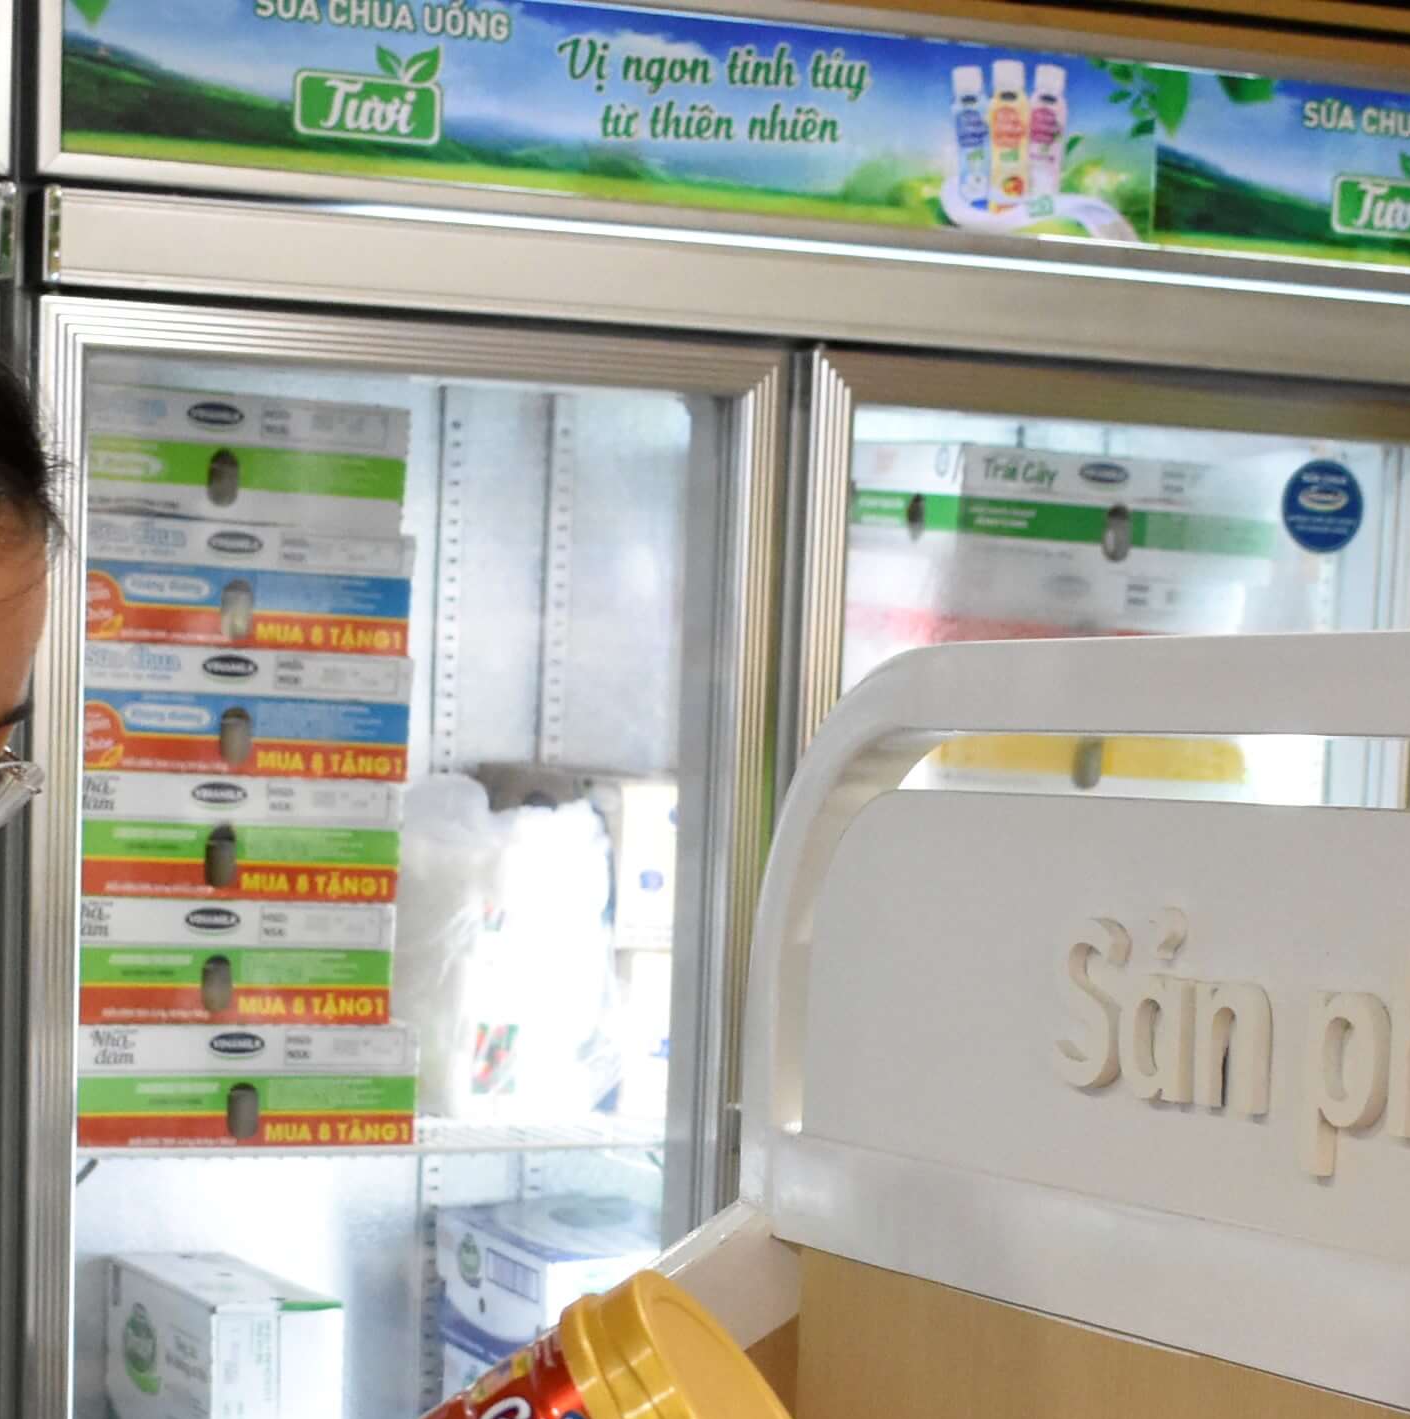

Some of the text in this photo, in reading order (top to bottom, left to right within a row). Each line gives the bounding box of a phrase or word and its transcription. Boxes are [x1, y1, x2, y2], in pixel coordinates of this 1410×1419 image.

[329, 0, 415, 34] CHUA
[425, 2, 511, 42] UỐNG
[558, 37, 607, 94] Vị
[622, 51, 712, 92] ngon
[320, 78, 418, 134] Tươi
[651, 101, 734, 142] thiên
[748, 104, 840, 144] nhiên
[1303, 99, 1356, 132] SỮA
[256, 622, 304, 644] MUA
[256, 750, 304, 771] MUA
[241, 871, 289, 892] MUA
[239, 995, 286, 1016] MUA
[1054, 907, 1274, 1116] Sản
[264, 1122, 313, 1142] MUA
